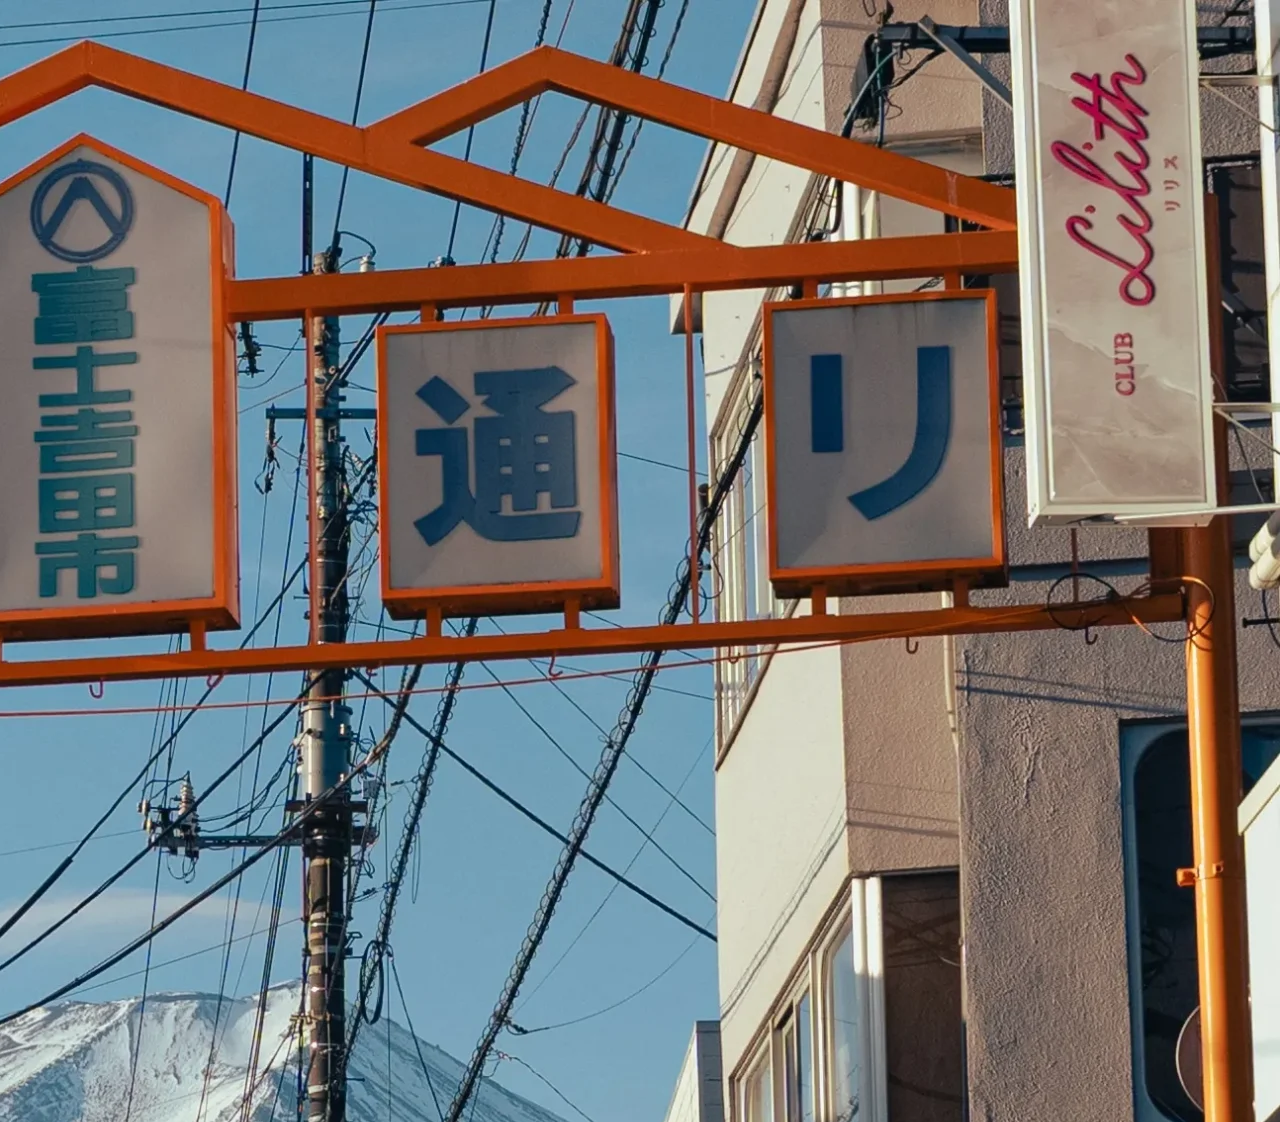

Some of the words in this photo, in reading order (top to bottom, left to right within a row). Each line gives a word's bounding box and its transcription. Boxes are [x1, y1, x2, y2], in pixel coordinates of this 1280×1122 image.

[1050, 53, 1156, 306] Lilith
[1163, 155, 1181, 211] リリス
[31, 265, 139, 598] 富士吉田市
[1113, 332, 1136, 396] CLUB
